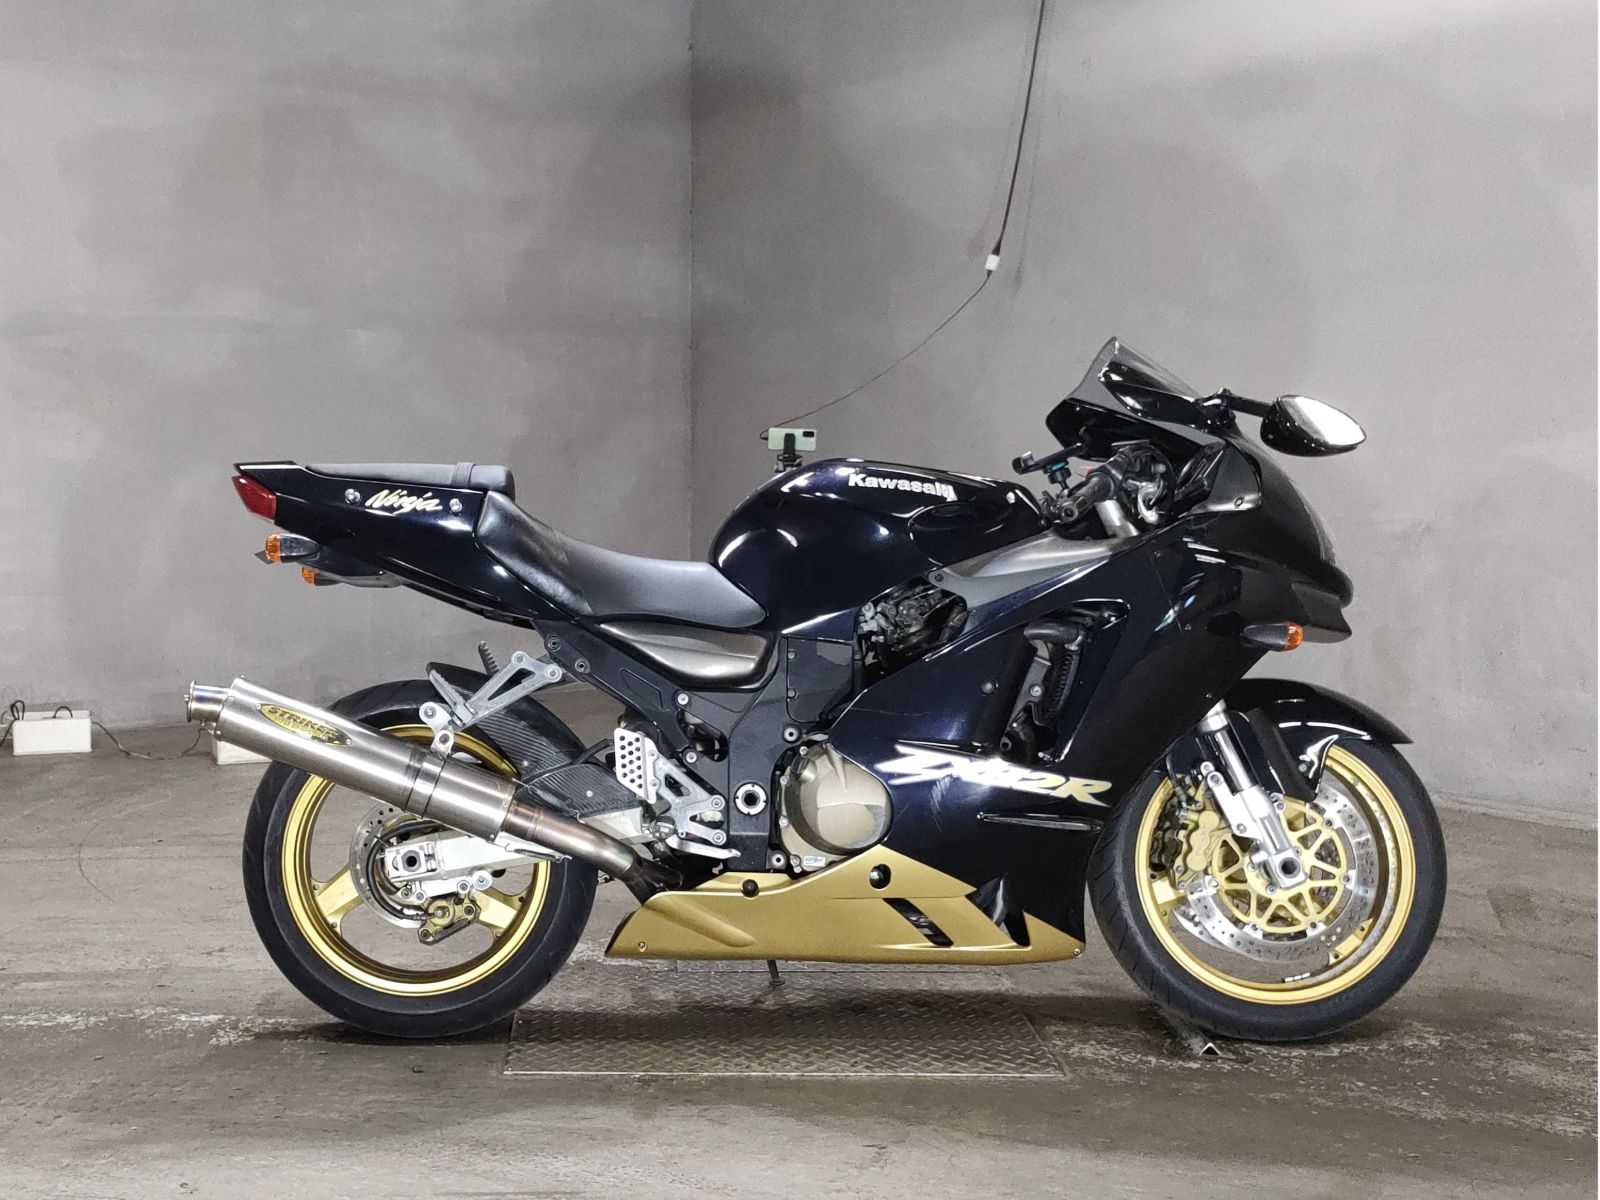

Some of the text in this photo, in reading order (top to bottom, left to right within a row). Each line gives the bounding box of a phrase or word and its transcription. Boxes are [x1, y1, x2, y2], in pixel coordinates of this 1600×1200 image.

[365, 489, 443, 515] Ninja
[848, 473, 958, 502] Kawasaki
[268, 706, 340, 740] STRIKER
